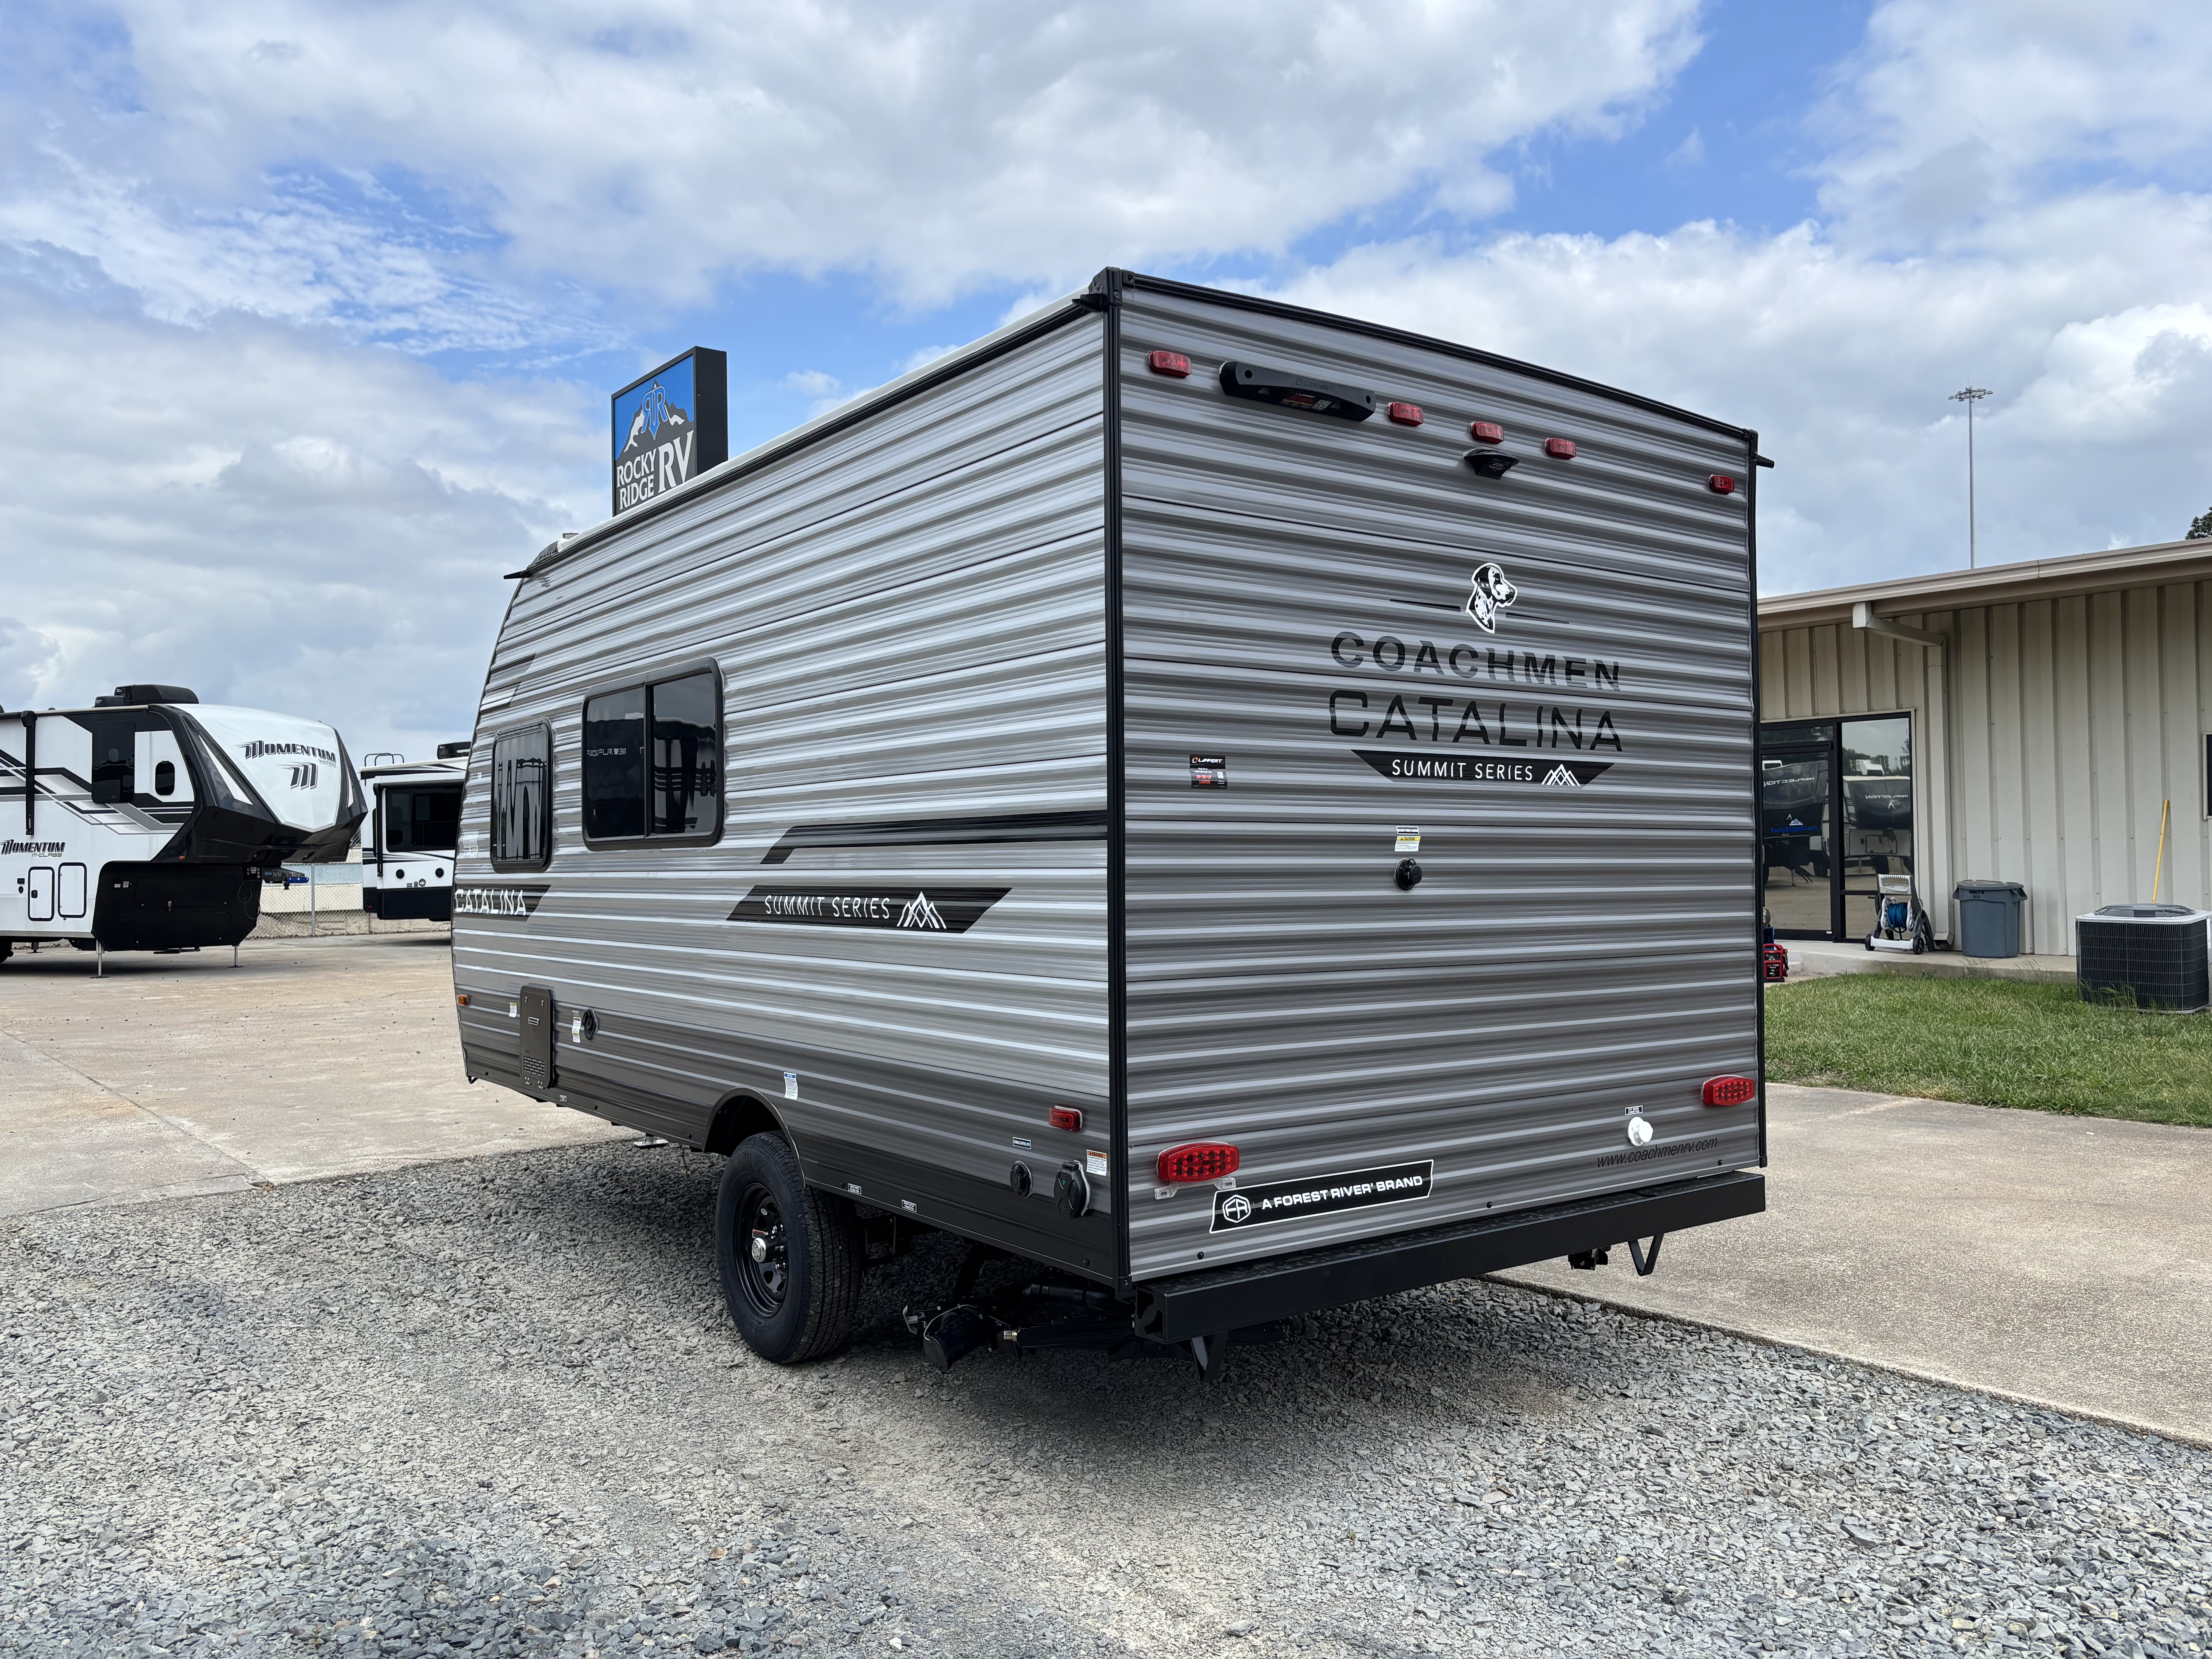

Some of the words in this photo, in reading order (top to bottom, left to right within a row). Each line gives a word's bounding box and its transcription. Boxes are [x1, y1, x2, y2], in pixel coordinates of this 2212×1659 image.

[617, 448, 656, 488] ROCKY
[658, 430, 694, 494] RV
[620, 474, 654, 510] RIDGE
[1331, 631, 1621, 692] COACHMEN
[1329, 690, 1623, 752] CATALINA
[1392, 759, 1467, 778] SUMMIT
[1475, 763, 1533, 781] SERIES
[454, 888, 526, 916] CATALINA
[765, 895, 825, 916] SUMMIT
[833, 897, 890, 919] SERIES
[1597, 1137, 1718, 1168] www.coachmenrv.com
[1262, 1199, 1273, 1210] A
[1274, 1189, 1329, 1207] FOREST
[1376, 1175, 1423, 1192] BRAND
